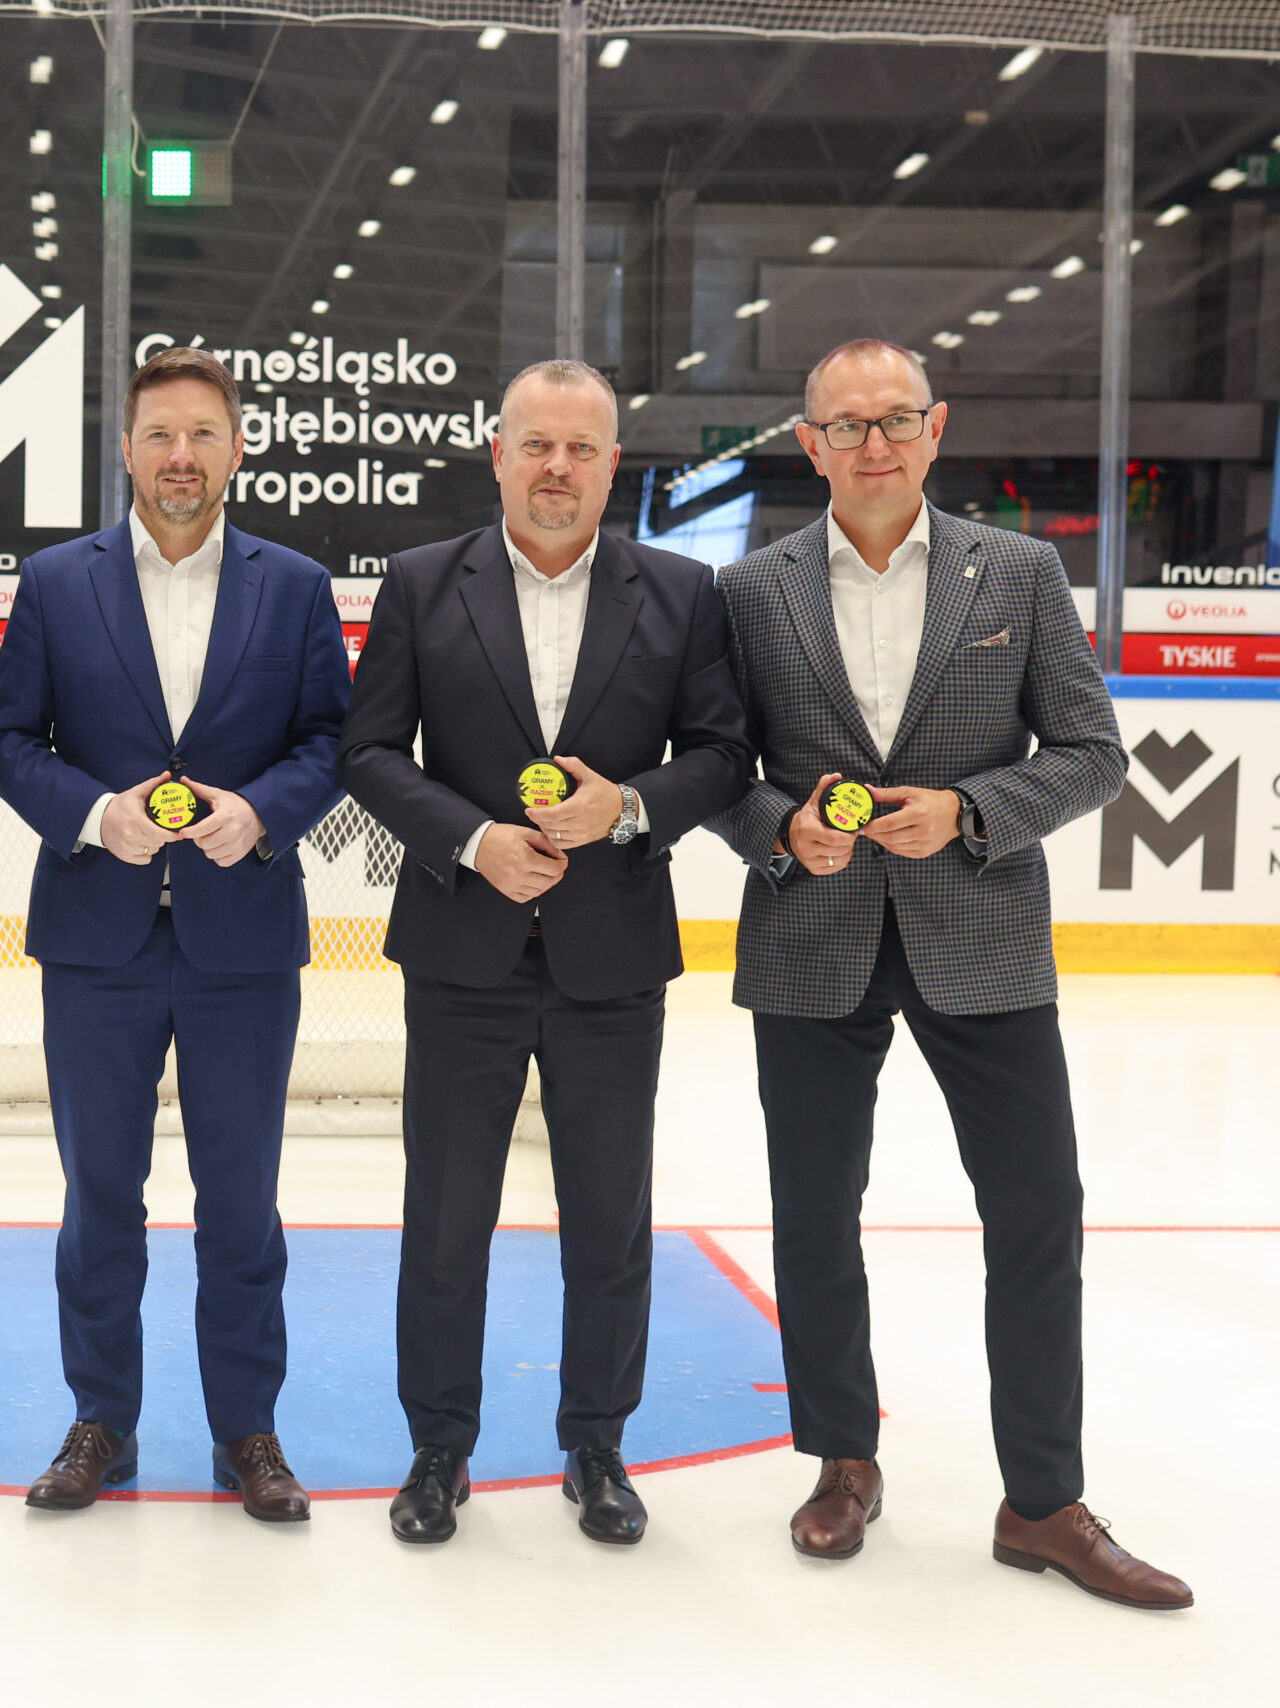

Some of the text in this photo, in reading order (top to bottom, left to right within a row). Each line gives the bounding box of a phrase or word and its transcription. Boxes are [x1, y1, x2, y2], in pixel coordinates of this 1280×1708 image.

[135, 333, 457, 396] Grnośląsko
[1189, 605, 1247, 618] VEOLIA
[1159, 645, 1237, 668] TYSKIE
